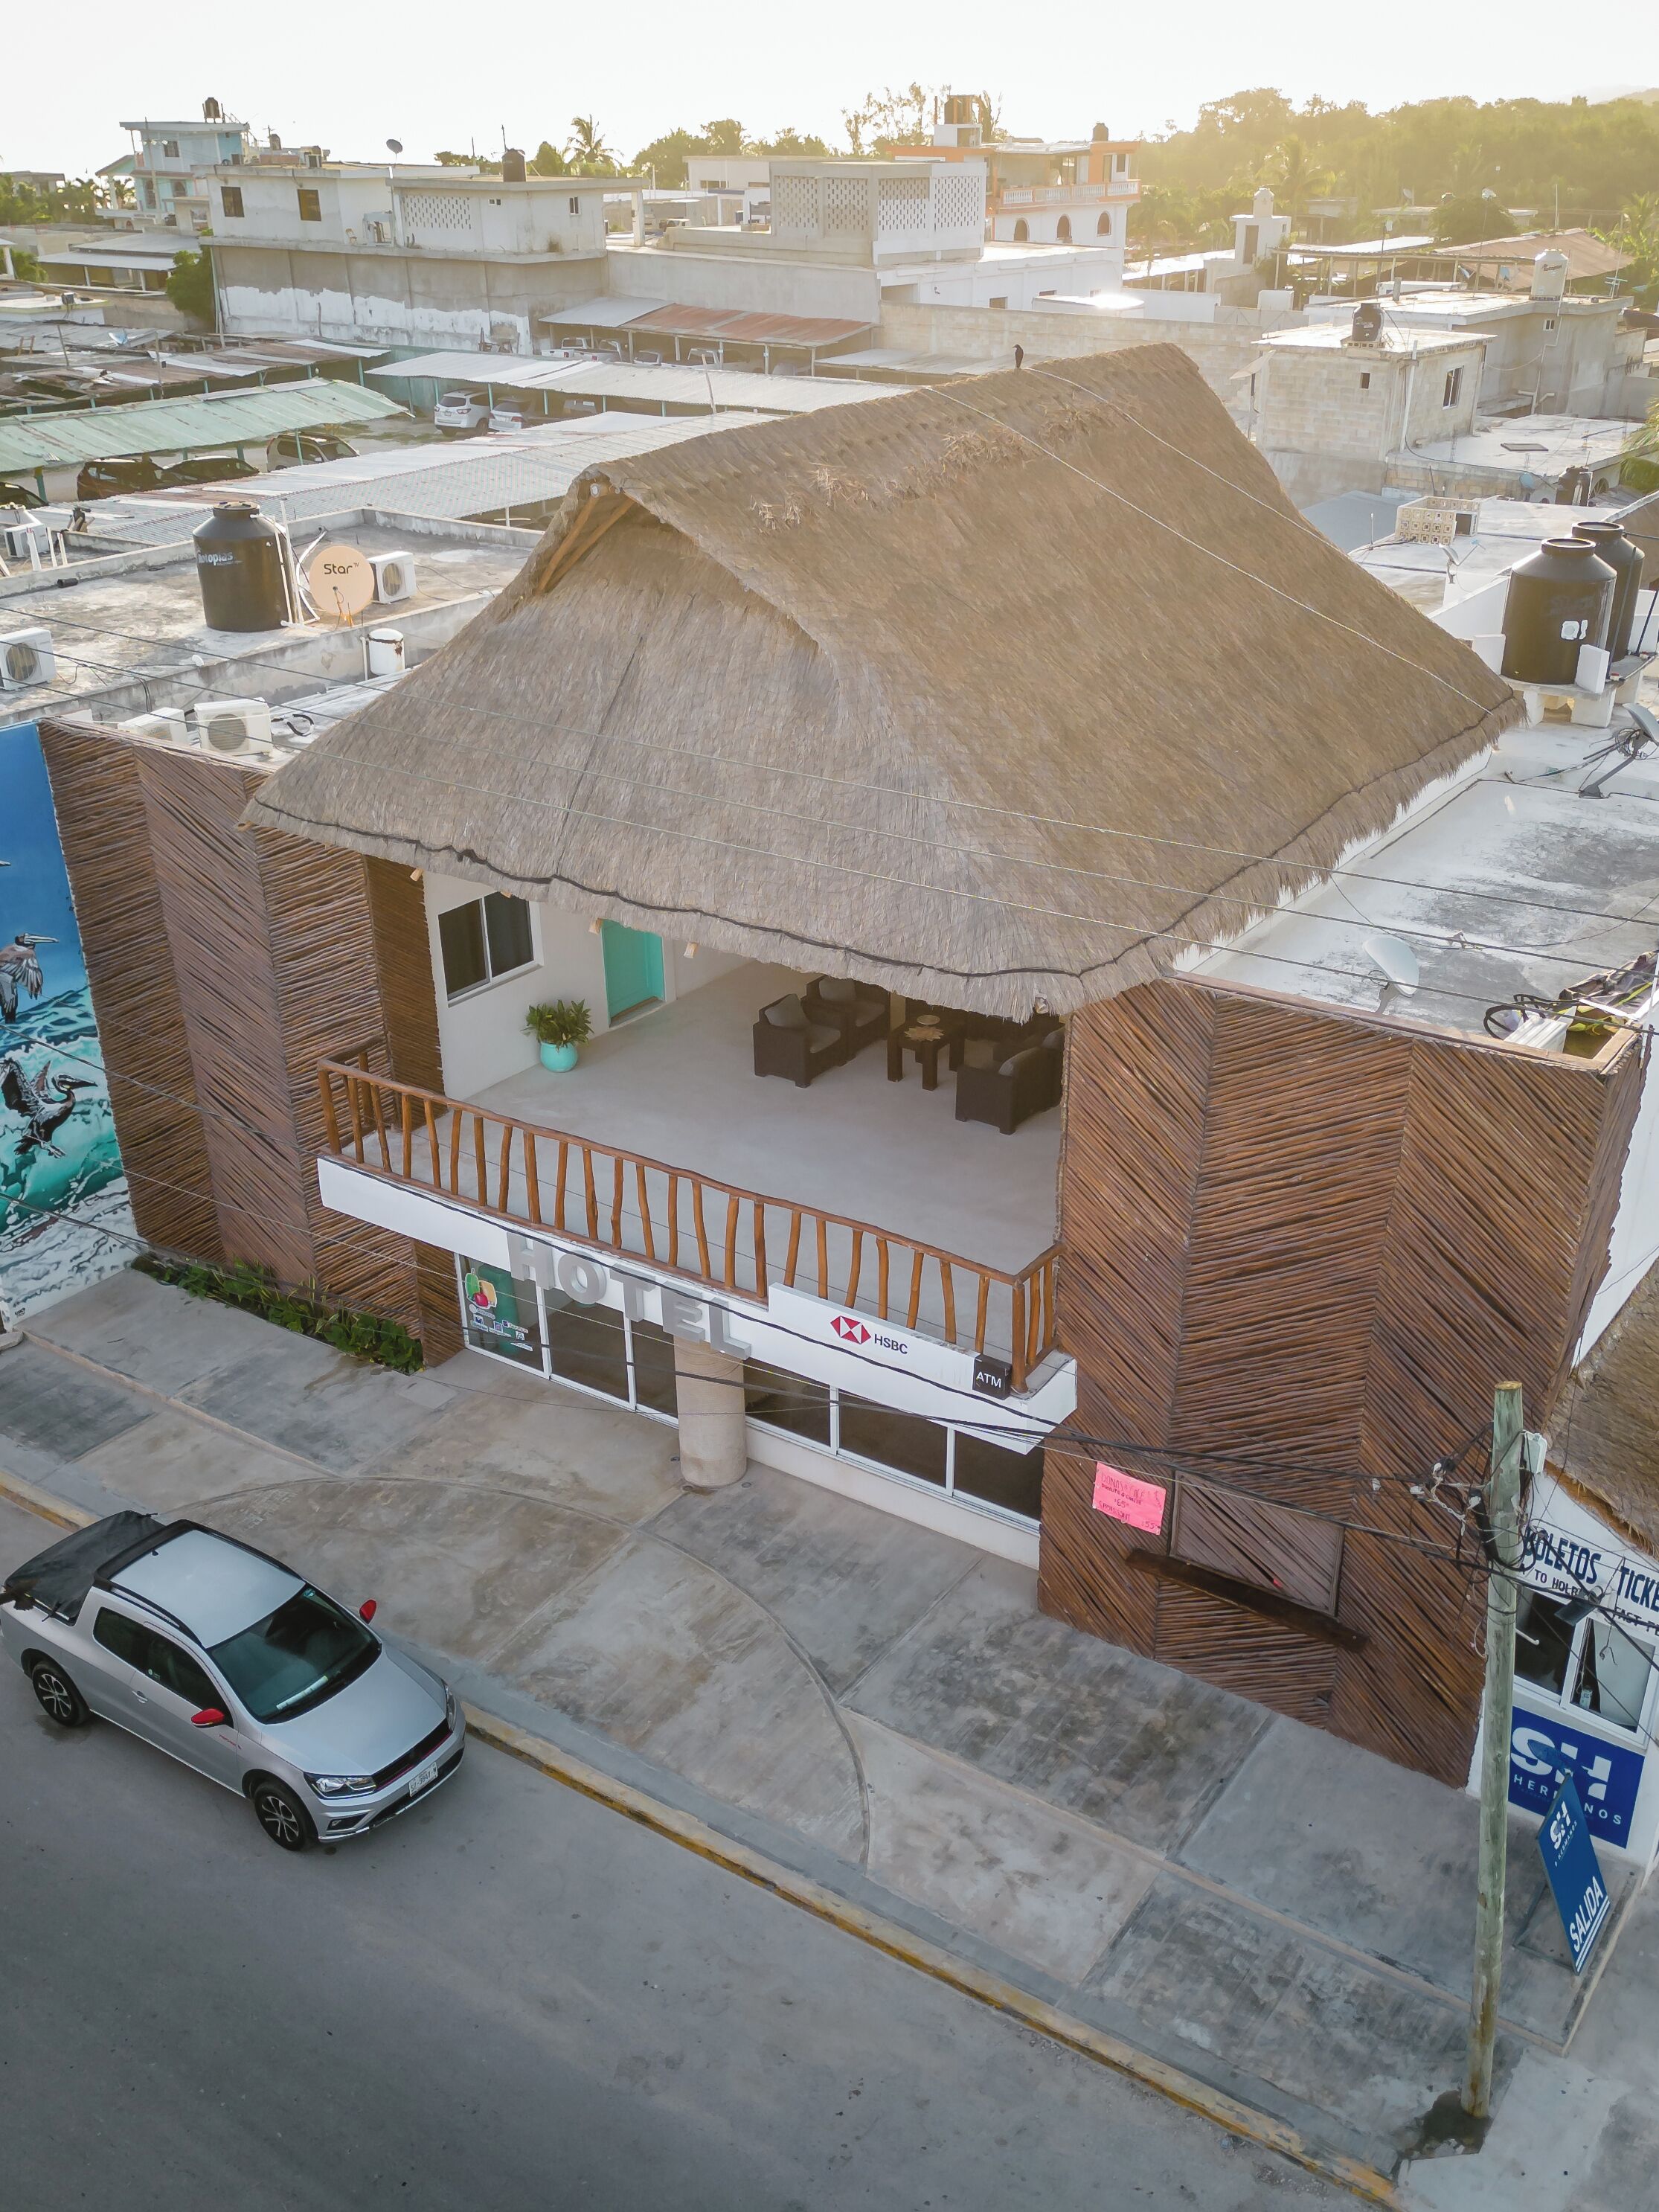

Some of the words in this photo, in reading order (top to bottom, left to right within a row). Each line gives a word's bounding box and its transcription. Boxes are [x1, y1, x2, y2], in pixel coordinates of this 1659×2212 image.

[324, 563, 353, 575] Star
[507, 1232, 751, 1360] HOTEL
[874, 1333, 908, 1355] HSBC
[976, 1371, 1001, 1389] ATM
[1535, 1569, 1547, 1583] TO
[1552, 1577, 1582, 1597] HOLB
[1513, 1774, 1622, 1825] HERNOS
[1569, 1875, 1604, 1953] SALIDA
